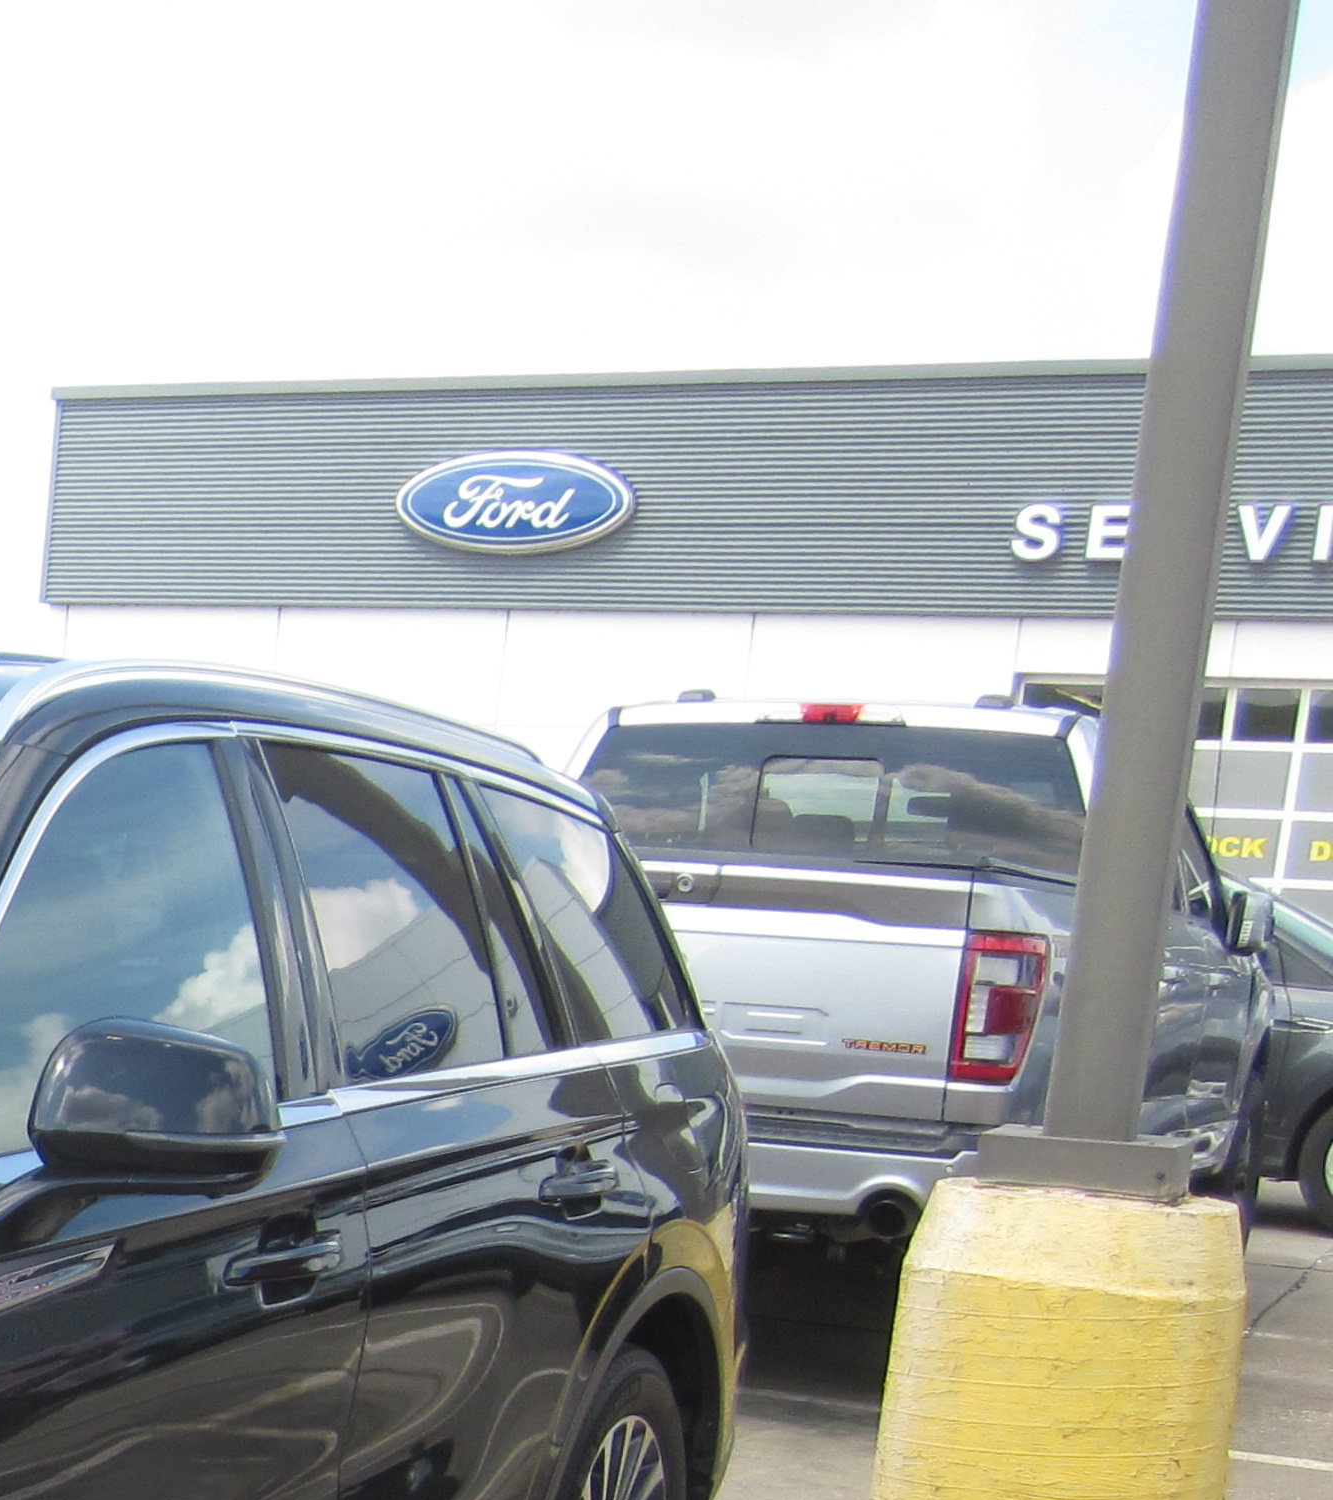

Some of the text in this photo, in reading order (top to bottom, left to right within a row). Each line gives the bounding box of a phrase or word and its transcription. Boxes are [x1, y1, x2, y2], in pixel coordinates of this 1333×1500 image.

[443, 474, 577, 529] Ford
[1010, 503, 1333, 561] SEVI
[841, 1038, 927, 1056] TREMOR
